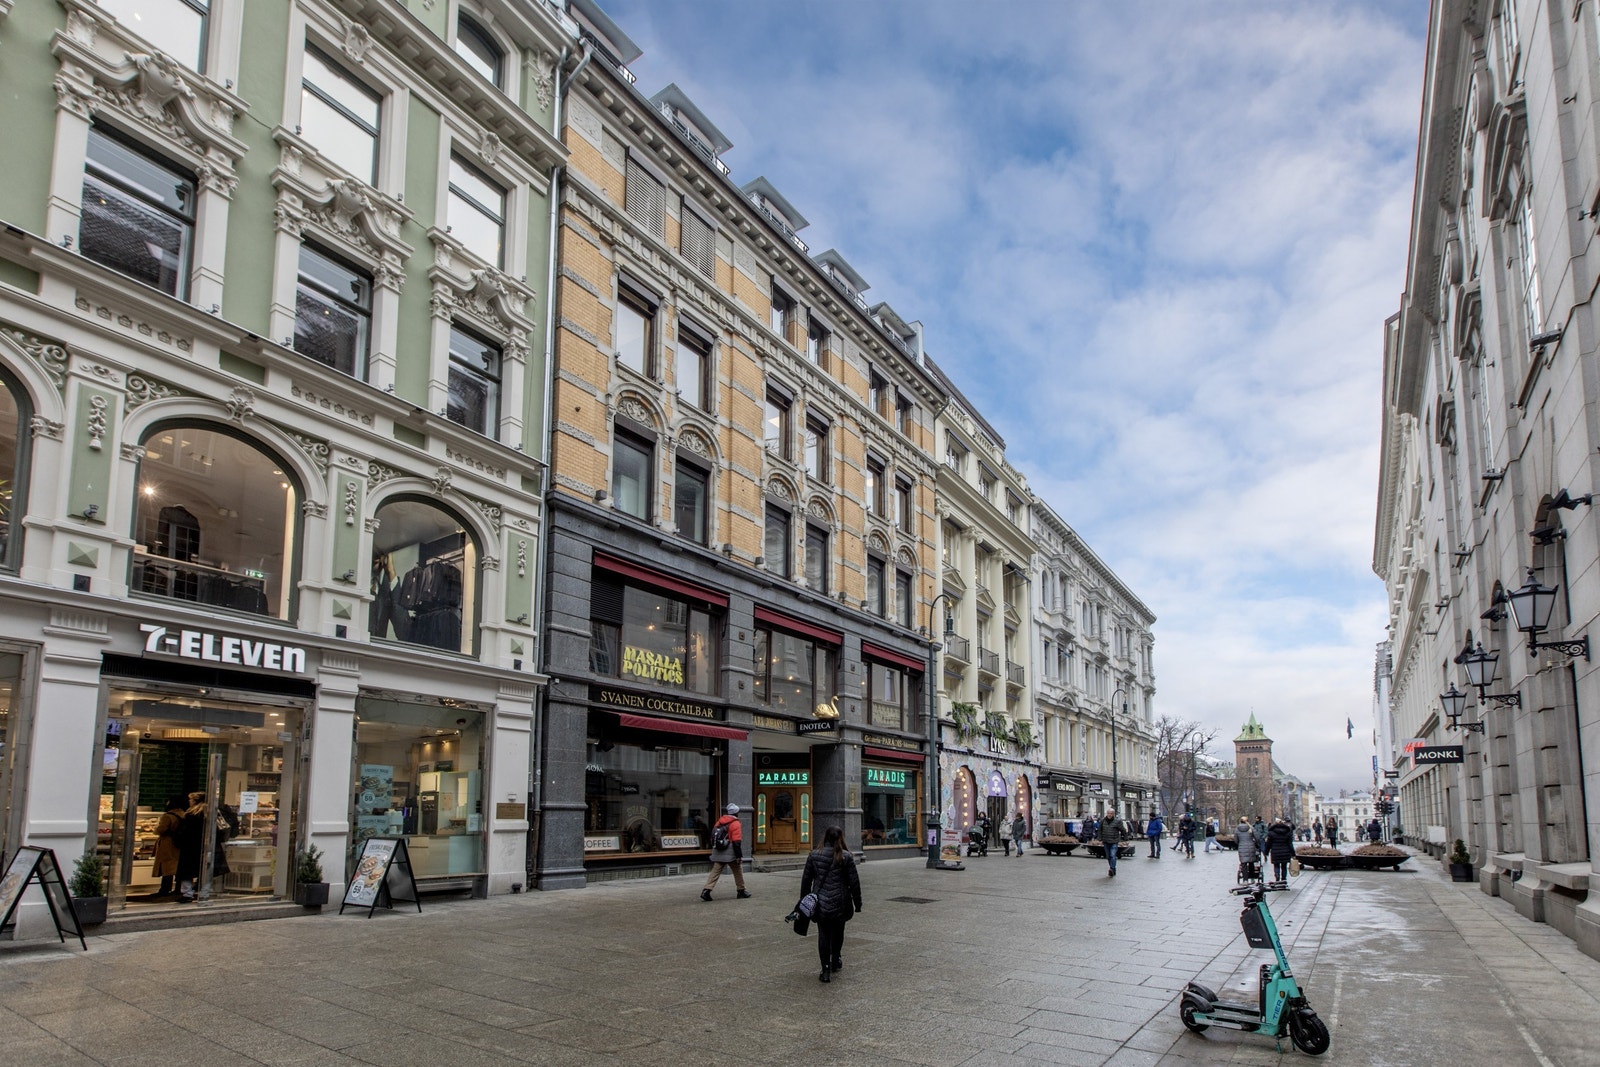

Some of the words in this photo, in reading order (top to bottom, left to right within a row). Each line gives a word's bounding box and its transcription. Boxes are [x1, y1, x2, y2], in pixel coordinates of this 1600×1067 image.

[624, 646, 681, 671] MASALA
[623, 660, 683, 684] POLITICS
[600, 690, 644, 708] SVANEN
[646, 698, 714, 718] COCKTAILBAR
[799, 722, 831, 731] ENOTECA
[759, 772, 808, 781] PARADIS
[868, 769, 905, 783] PARADIS
[663, 837, 698, 846] COCKTAILS
[352, 885, 362, 894] 59
[1273, 1000, 1283, 1020] TIER
